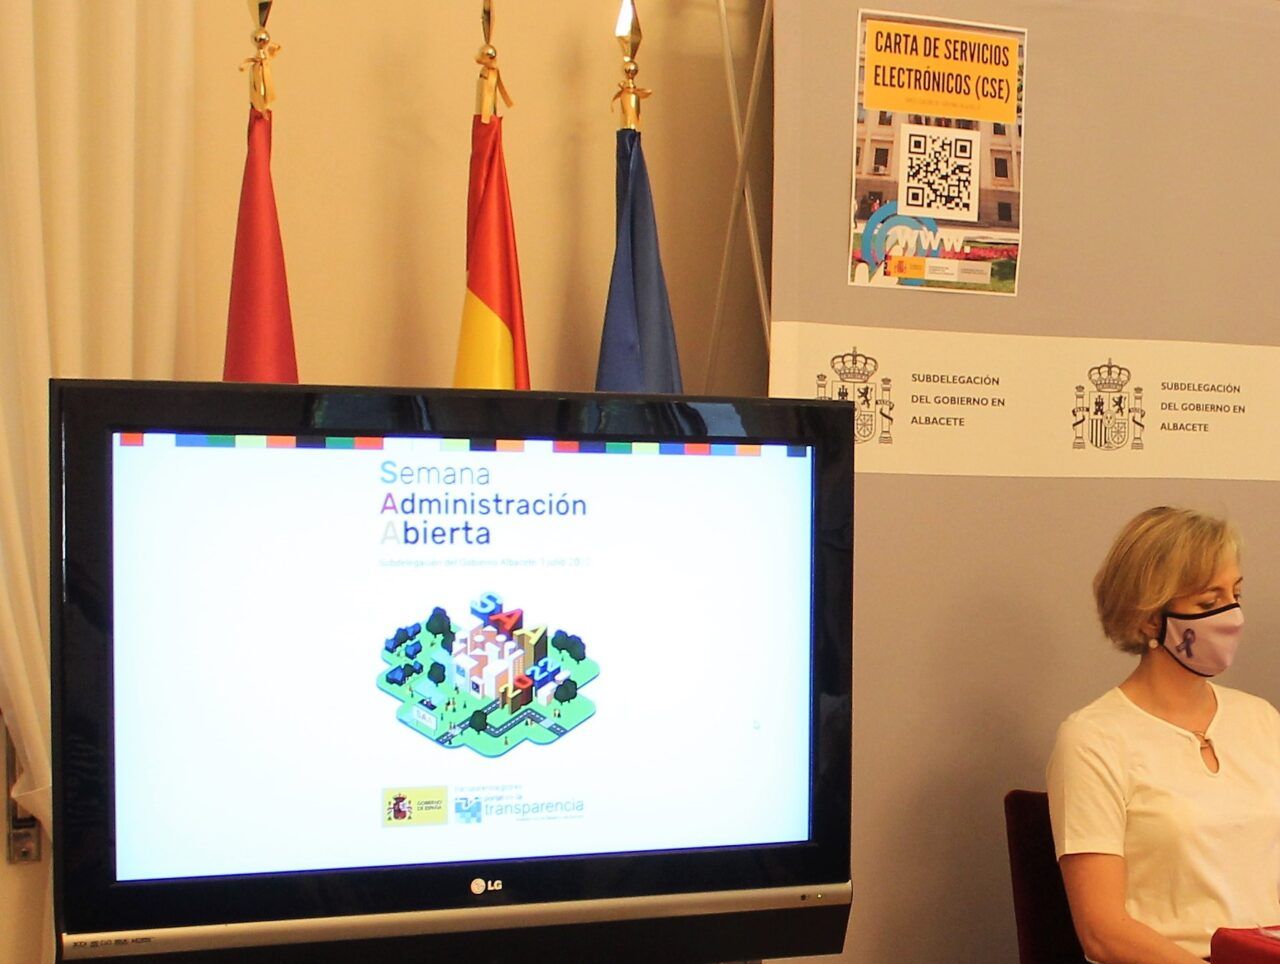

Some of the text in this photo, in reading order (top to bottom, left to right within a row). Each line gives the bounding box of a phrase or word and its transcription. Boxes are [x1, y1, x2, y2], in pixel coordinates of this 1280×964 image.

[876, 31, 1009, 67] CARTA DE SERVICIOS
[874, 65, 971, 96] ELECTRÓNICOS
[975, 78, 1011, 104] (CSE)
[912, 373, 1000, 386] SUBDELEGACIÓN
[1161, 382, 1241, 393] SUBDELEGACIÓN
[911, 395, 1005, 407] DEL GOBIERNO EN
[1161, 403, 1245, 413] DEL GOBIERNO EN
[911, 416, 965, 426] ALBACETE
[1160, 423, 1209, 432] ALBACETE
[380, 460, 490, 485] Semana
[380, 492, 587, 515] Administración
[380, 520, 490, 545] Abierta
[485, 797, 584, 816] transparencia
[487, 880, 503, 891] LG
